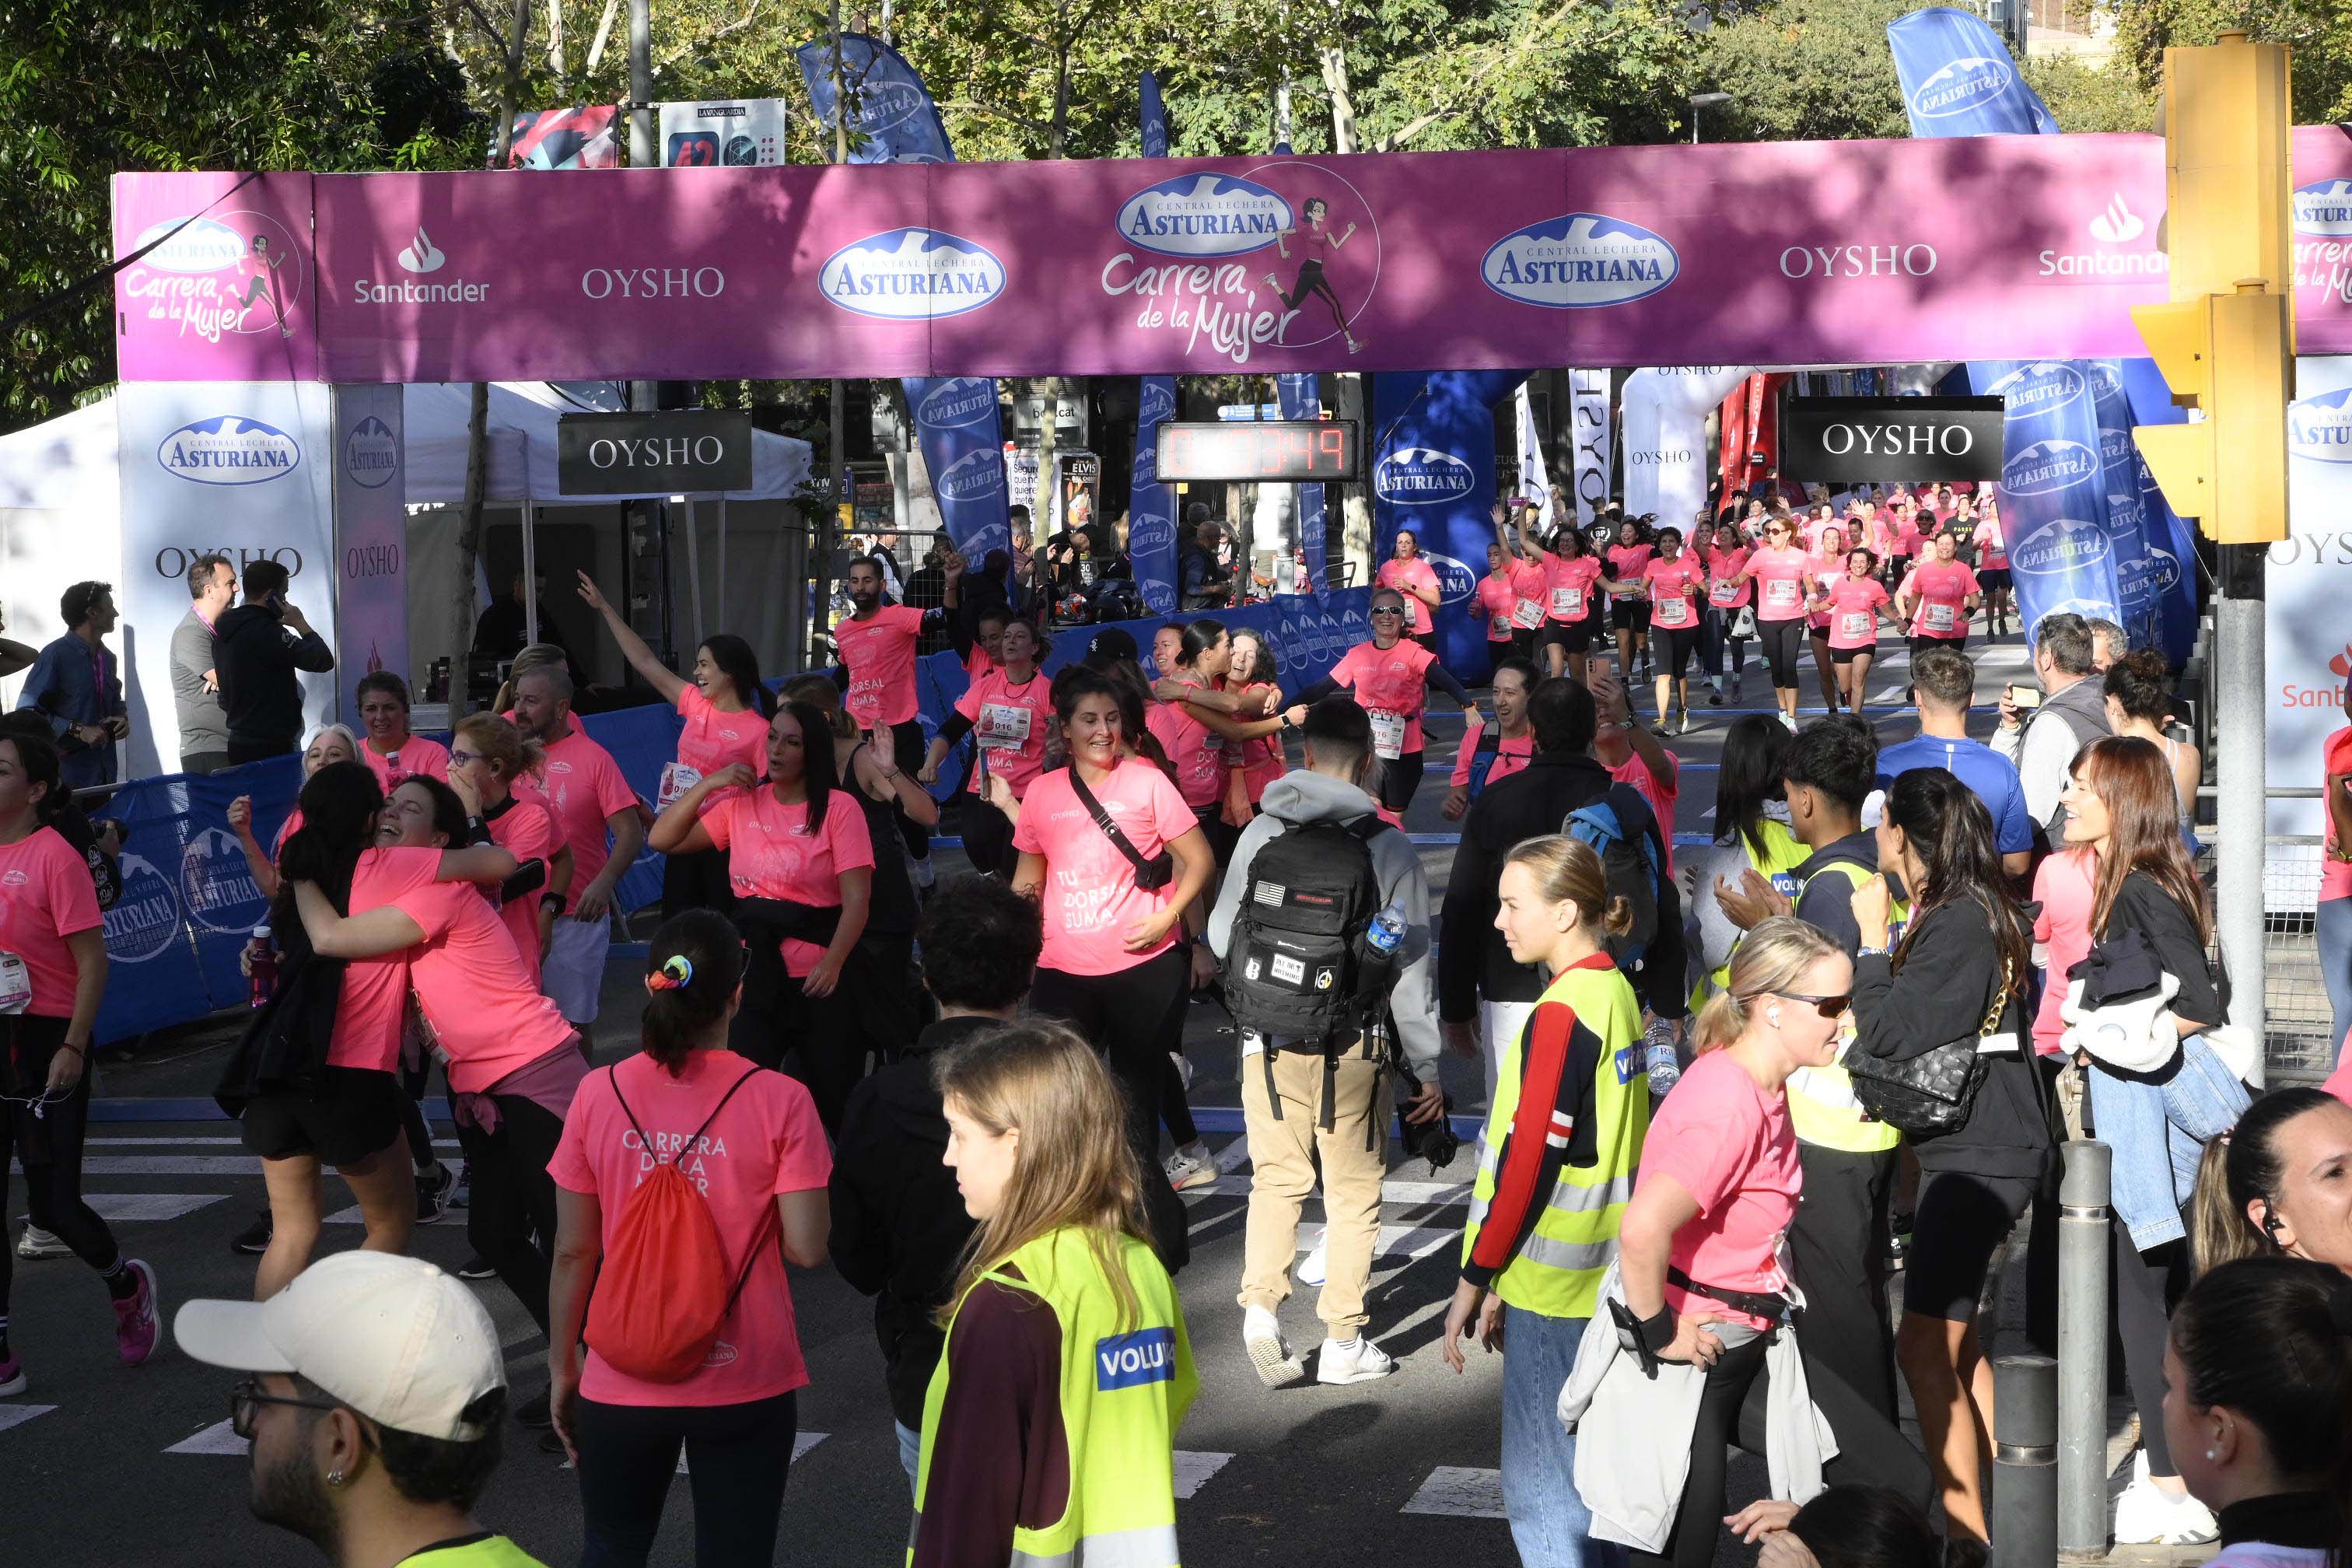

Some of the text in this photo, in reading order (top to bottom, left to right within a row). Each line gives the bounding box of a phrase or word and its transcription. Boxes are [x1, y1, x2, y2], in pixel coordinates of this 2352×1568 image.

[705, 107, 744, 117] VANGUARDIA
[1157, 200, 1274, 211] CENTRAL LECHERA
[1129, 205, 1279, 236] ASTURIANA
[1527, 245, 1657, 256] CENTRAL LECHERA
[1780, 243, 1937, 278] OYSHO
[2039, 250, 2170, 276] Santand
[833, 261, 992, 296] ASTURIANA
[1101, 252, 1248, 296] Carrera
[1496, 250, 1664, 285] ASTURIANA
[124, 268, 219, 298] Carrera
[355, 278, 490, 305] Santander
[582, 266, 725, 299] OYSHO
[149, 294, 253, 344] de la Mujer
[1137, 289, 1302, 363] de la Mujer
[169, 441, 290, 467] ASTURIANA
[190, 439, 235, 447] CENTRAL
[589, 436, 723, 469] OYSHO
[1822, 424, 1973, 457] OYSHO
[349, 444, 395, 471] ASTURIANA
[1072, 463, 1096, 473] ELVIS
[1631, 449, 1692, 466] OYSHO
[1378, 470, 1468, 492] ASTURIANA
[347, 544, 399, 579] OYSHO
[1080, 564, 1090, 572] 30
[996, 723, 1013, 731] 016
[1057, 870, 1078, 887] TU
[1066, 908, 1115, 929] SUMA
[622, 1129, 727, 1157] CARRERA
[640, 1152, 670, 1171] DE
